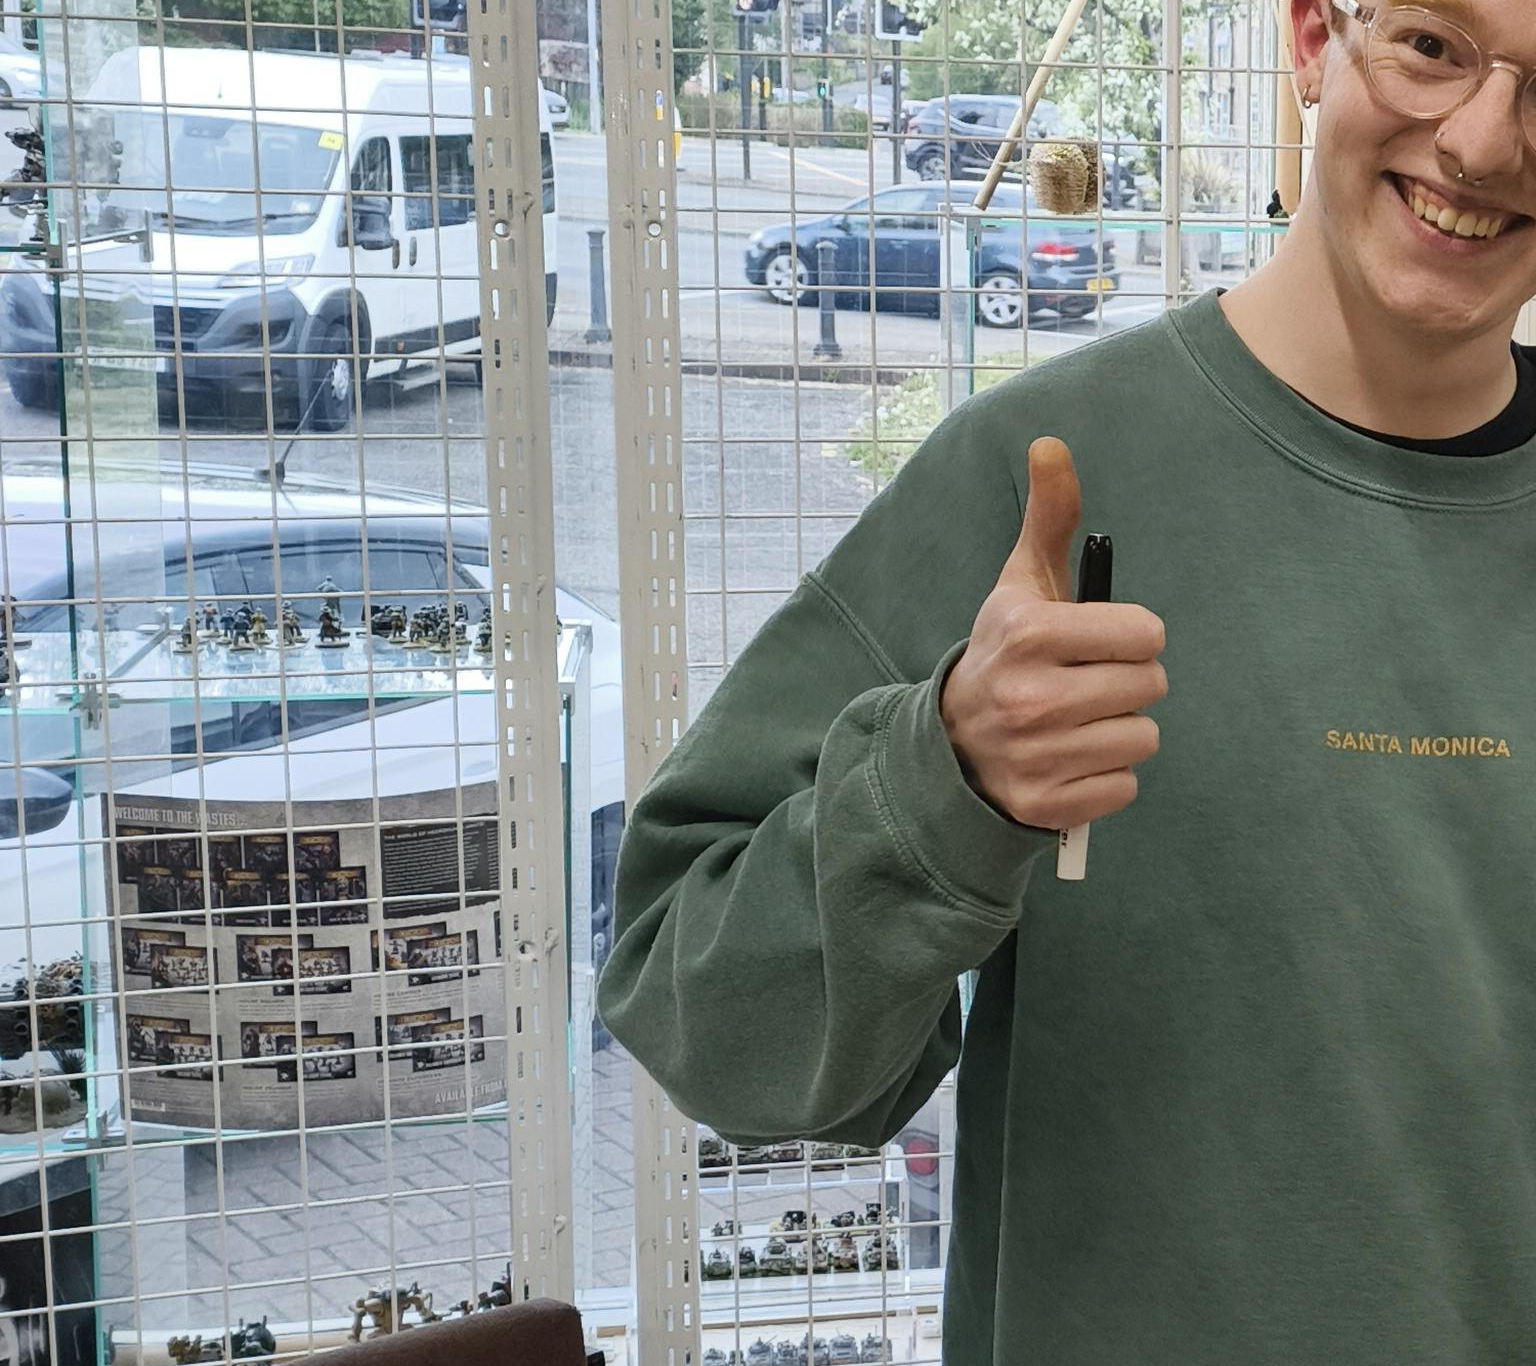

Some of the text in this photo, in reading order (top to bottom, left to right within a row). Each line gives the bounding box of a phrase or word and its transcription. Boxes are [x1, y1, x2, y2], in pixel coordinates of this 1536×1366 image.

[1325, 729, 1512, 758] SANTA MONICA
[114, 806, 159, 822] WELCOME
[161, 809, 174, 823] TO
[175, 810, 194, 824] THE
